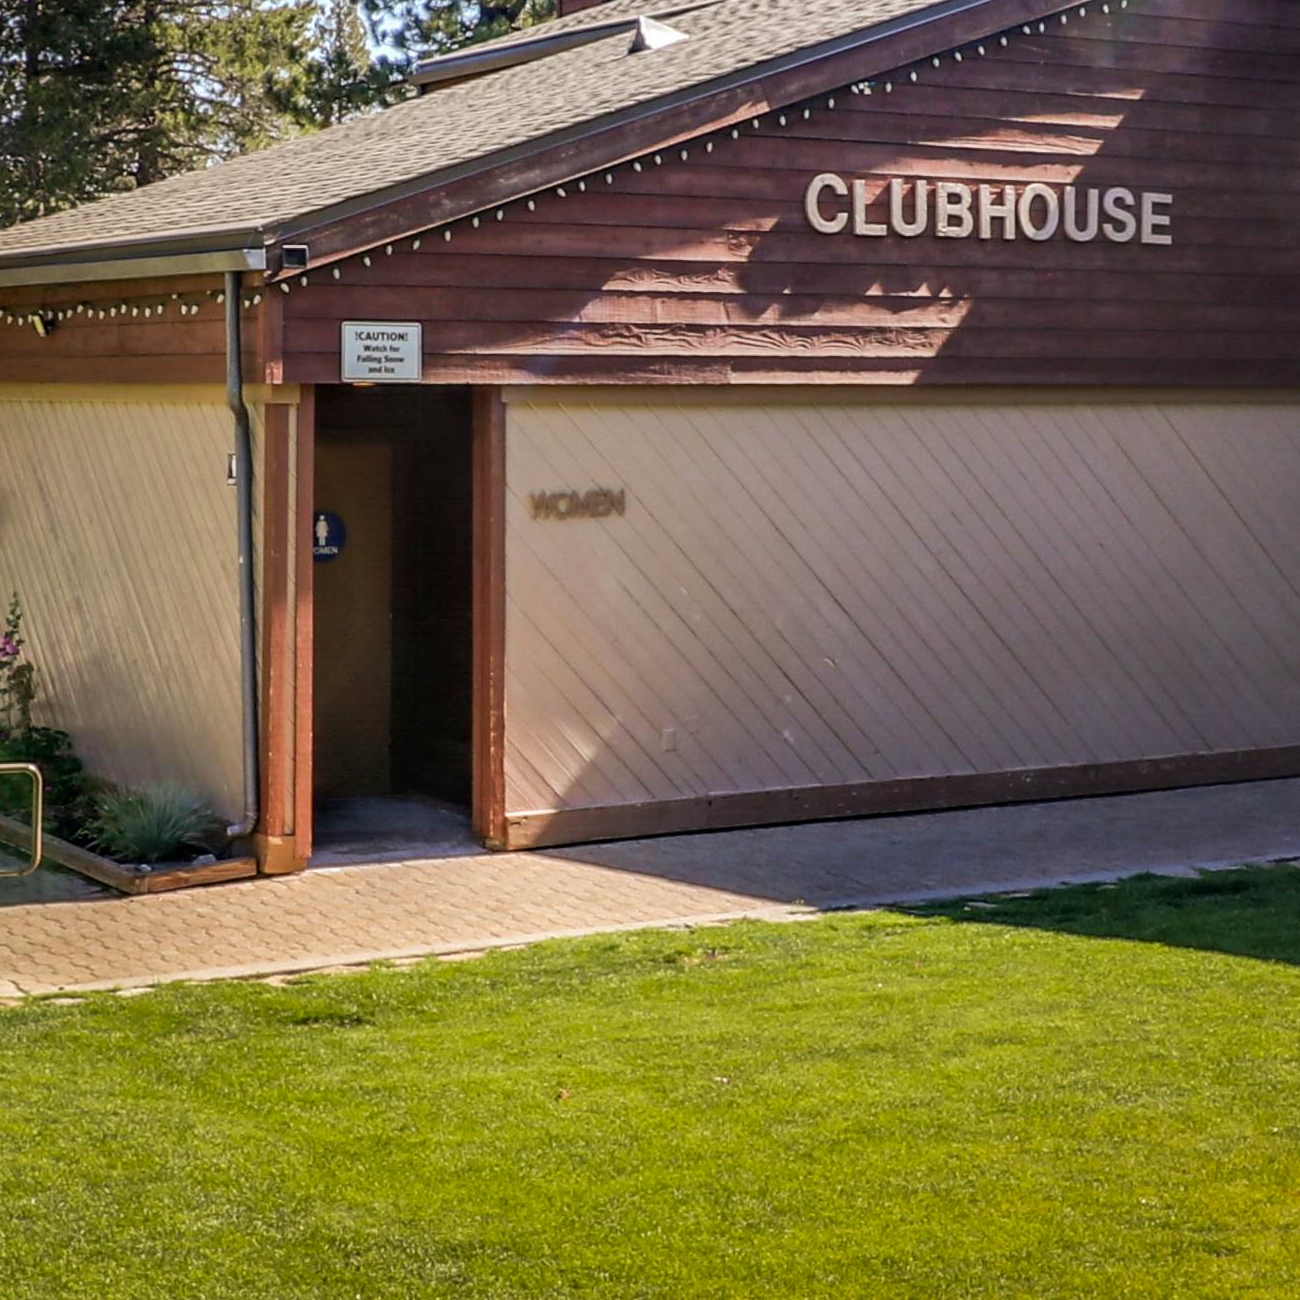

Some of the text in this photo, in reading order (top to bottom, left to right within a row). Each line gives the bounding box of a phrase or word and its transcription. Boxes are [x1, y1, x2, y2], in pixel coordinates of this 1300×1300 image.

[804, 172, 1174, 246] CLUBHOUSE
[363, 344, 400, 353] Watch for
[356, 354, 405, 364] Falling Snow
[368, 366, 395, 374] and Ice
[313, 546, 339, 555] OMEN
